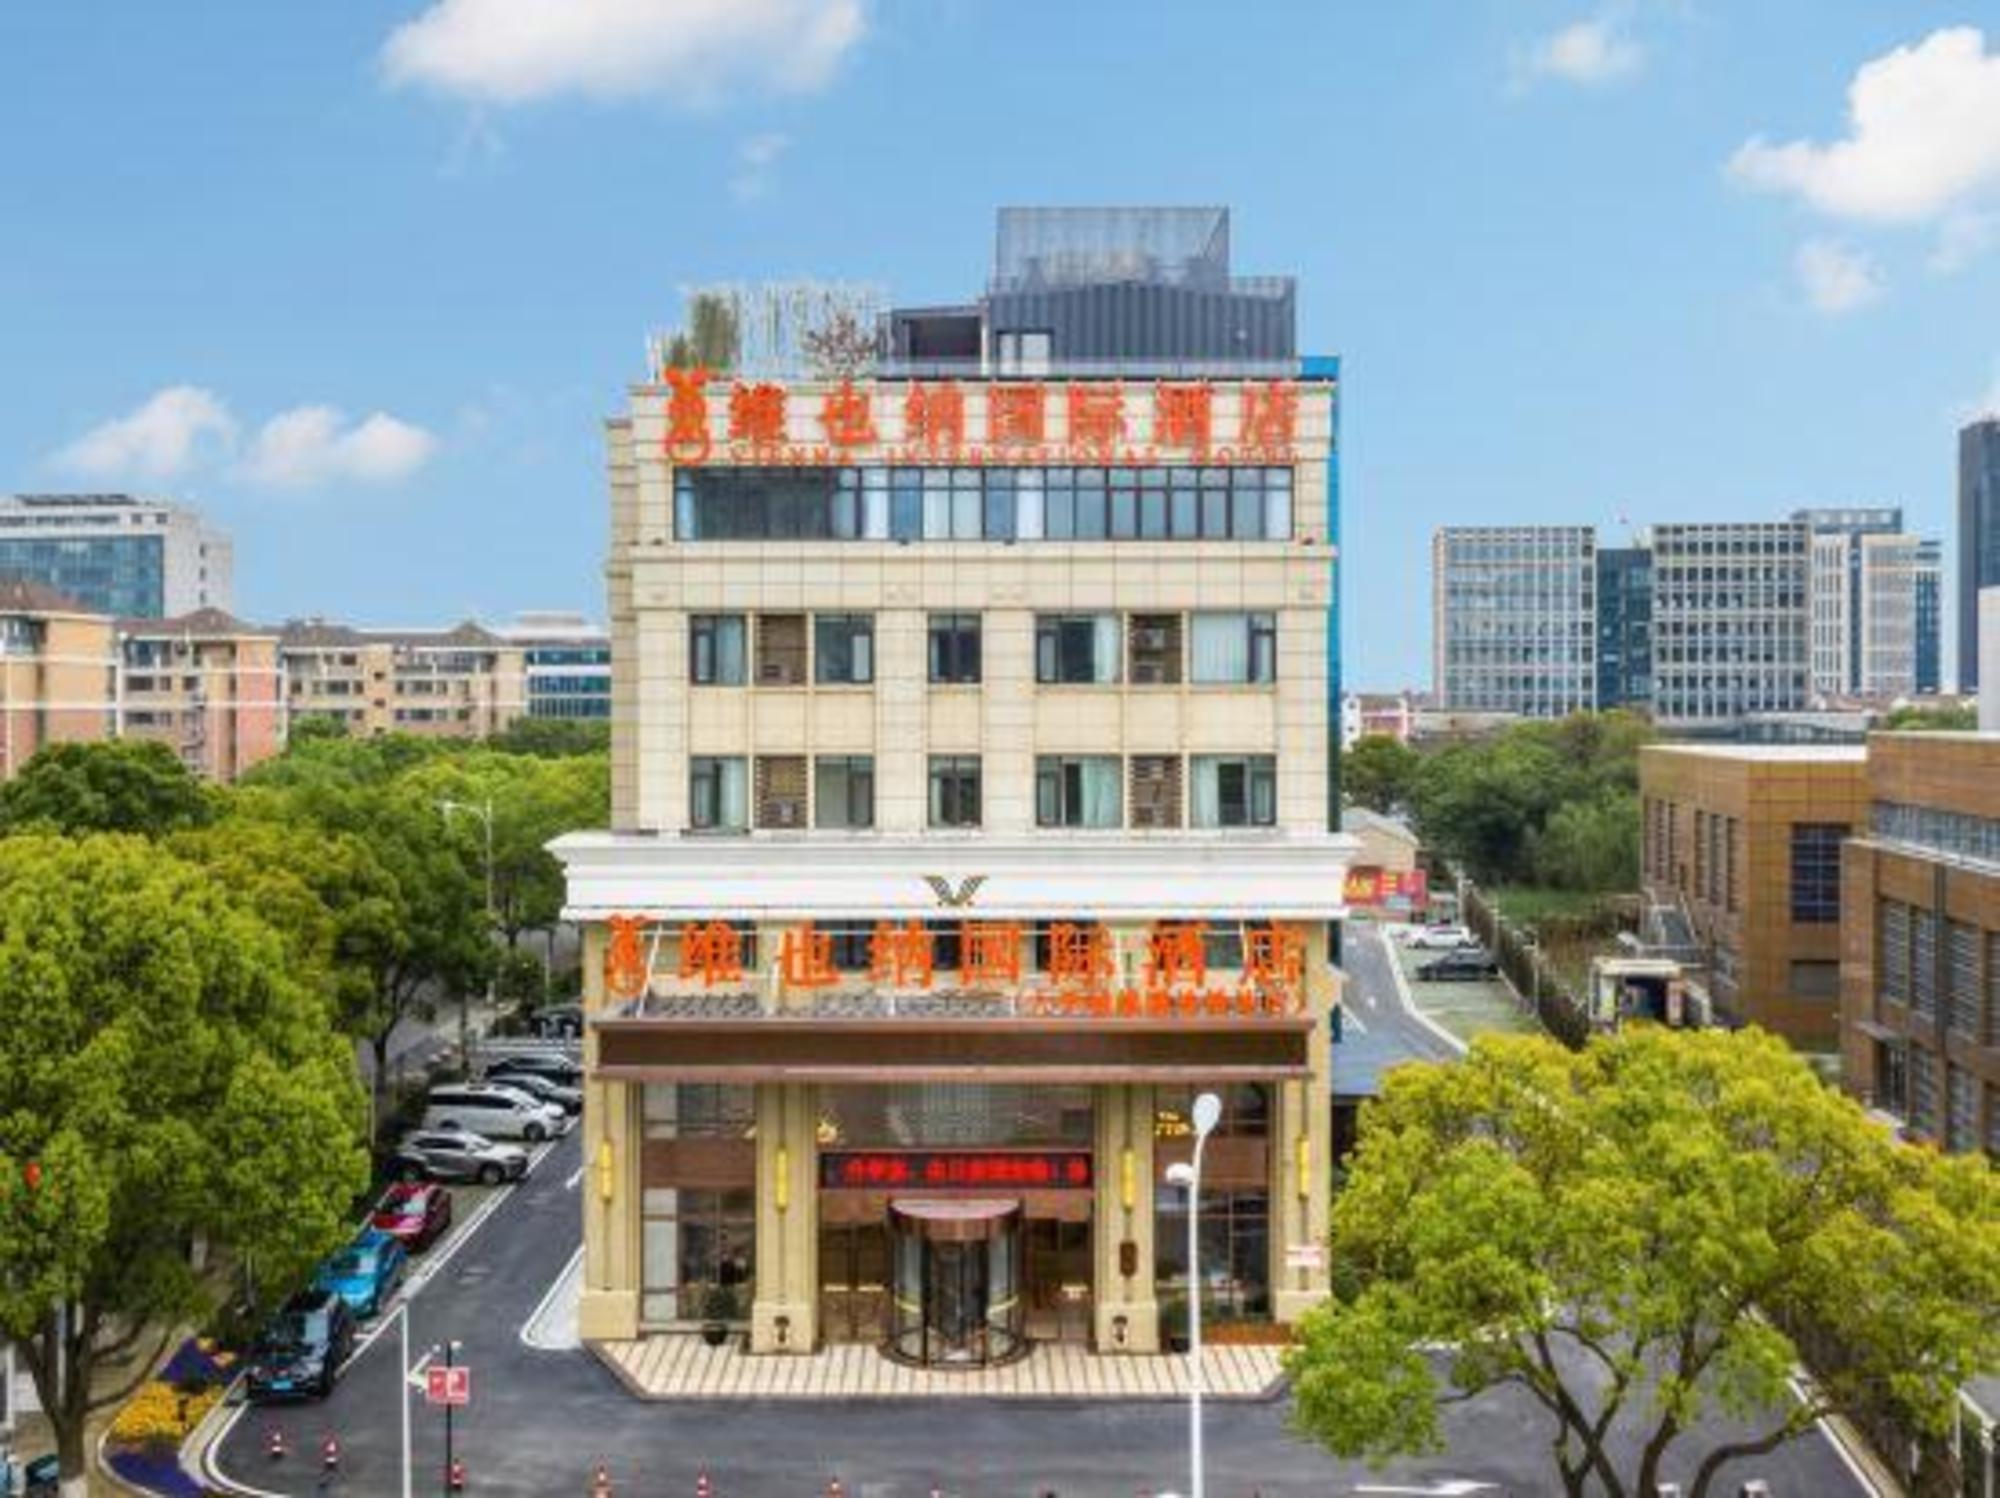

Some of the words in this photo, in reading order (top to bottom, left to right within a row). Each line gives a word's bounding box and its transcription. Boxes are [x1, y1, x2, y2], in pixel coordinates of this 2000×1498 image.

[680, 919, 1300, 988] 维也纳国际酒店
